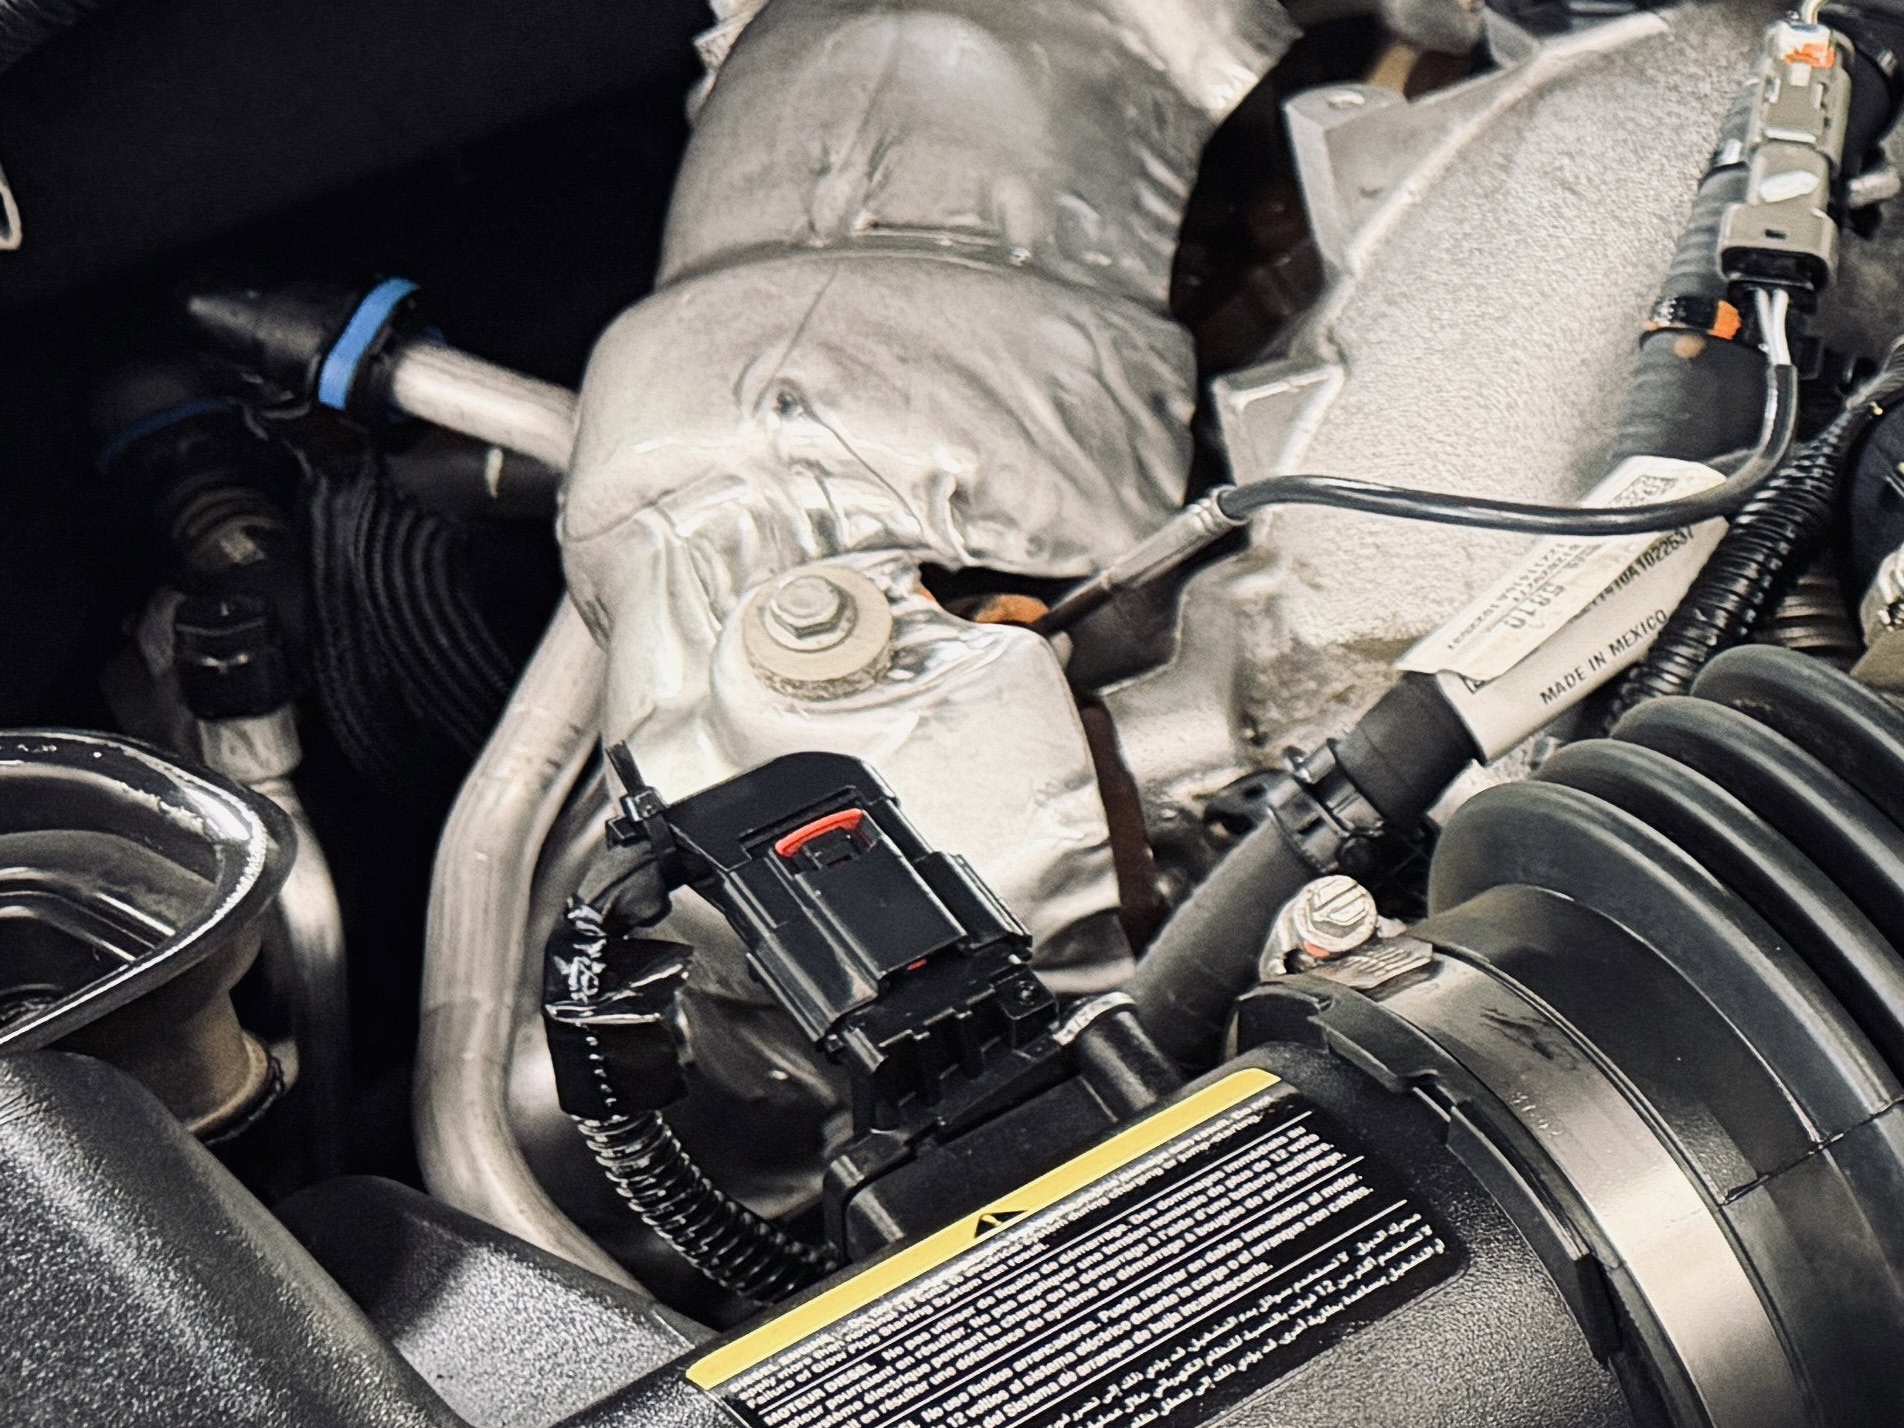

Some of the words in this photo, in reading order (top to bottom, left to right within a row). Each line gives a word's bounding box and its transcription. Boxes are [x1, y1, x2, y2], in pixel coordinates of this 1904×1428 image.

[1540, 668, 1584, 704] MADE
[1588, 655, 1607, 672] IN
[1608, 609, 1669, 656] MEXICO
[764, 1388, 825, 1425] MOTEUR
[881, 1346, 904, 1361] Ne
[904, 1332, 931, 1350] pas
[930, 1306, 976, 1334] utiliser
[976, 1296, 996, 1309] de
[994, 1272, 1040, 1299] liquide
[1040, 1261, 1059, 1274] de
[1058, 1224, 1131, 1264] démarrage.
[1128, 1208, 1157, 1224] Des
[1156, 1171, 1225, 1210] dommages
[1223, 1136, 1288, 1173] immédiats
[1287, 1126, 1306, 1138] au
[825, 1366, 896, 1410] pourraient
[895, 1356, 915, 1370] en
[915, 1327, 971, 1359] résulter.
[969, 1314, 991, 1328] Ne
[990, 1300, 1017, 1318] pas
[1017, 1266, 1076, 1303] appliquer
[1077, 1252, 1104, 1269] une
[1101, 1226, 1151, 1255] tension
[1150, 1195, 1208, 1229] nominale
[1206, 1185, 1226, 1197] de
[1224, 1170, 1254, 1189] plus
[1252, 1160, 1271, 1172] de
[1269, 1149, 1289, 1161] 12
[1287, 1134, 1319, 1152] volts
[860, 1409, 880, 1424] en
[879, 1381, 929, 1413] résulter
[929, 1366, 956, 1385] une
[1024, 1317, 1044, 1332] du
[1043, 1287, 1098, 1321] système
[1097, 1277, 1117, 1290] de
[1116, 1239, 1185, 1280] démarrage
[1194, 1206, 1245, 1236] bougies
[1243, 1196, 1263, 1209] de
[1262, 1152, 1346, 1200] préchauffage.
[864, 1363, 931, 1404] électrique
[931, 1332, 987, 1368] pendant
[983, 1325, 1002, 1336] la
[1000, 1299, 1047, 1328] charge
[1046, 1289, 1066, 1302] ou
[1063, 1281, 1080, 1292] le
[1079, 1243, 1148, 1284] démarrage
[1228, 1172, 1277, 1200] batterie
[1276, 1143, 1334, 1175] auxiliaire.
[921, 1407, 944, 1422] No
[942, 1392, 969, 1411] use
[967, 1368, 1013, 1396] fluidos
[1013, 1321, 1100, 1371] arrancadores.
[1097, 1296, 1140, 1322] Puede
[1139, 1269, 1187, 1300] resultar
[1187, 1259, 1206, 1273] en
[1204, 1238, 1243, 1263] daños
[1241, 1202, 1309, 1242] inmediatos
[1307, 1192, 1323, 1205] al
[1320, 1173, 1362, 1198] motor.
[946, 1412, 967, 1428] 12
[1009, 1379, 1024, 1394] al
[1023, 1352, 1077, 1386] sistema
[1075, 1321, 1131, 1356] eléctrico
[1130, 1294, 1179, 1324] durante
[1175, 1286, 1193, 1298] la
[1191, 1266, 1230, 1290] carga
[1227, 1259, 1239, 1269] o
[1237, 1250, 1253, 1264] el
[1251, 1222, 1306, 1256] arranque
[1304, 1208, 1330, 1226] con
[1328, 1187, 1373, 1212] cables.
[1314, 1280, 1336, 1295] 12
[1337, 1251, 1349, 1262] لا
[1420, 1224, 1432, 1236] لا
[746, 1380, 795, 1409] Failure
[795, 1369, 812, 1382] of
[811, 1351, 847, 1373] Glow
[847, 1334, 880, 1354] Plug
[878, 1305, 934, 1336] Starting
[932, 1278, 982, 1307] System
[981, 1264, 1008, 1280] can
[1007, 1243, 1049, 1266] result.
[778, 1357, 812, 1379] more
[983, 1410, 1006, 1428] del
[1003, 1382, 1060, 1416] Sistema
[1057, 1370, 1077, 1386] de
[1076, 1339, 1134, 1376] arranque
[1132, 1329, 1151, 1344] de
[1179, 1262, 1272, 1316] incandescente.
